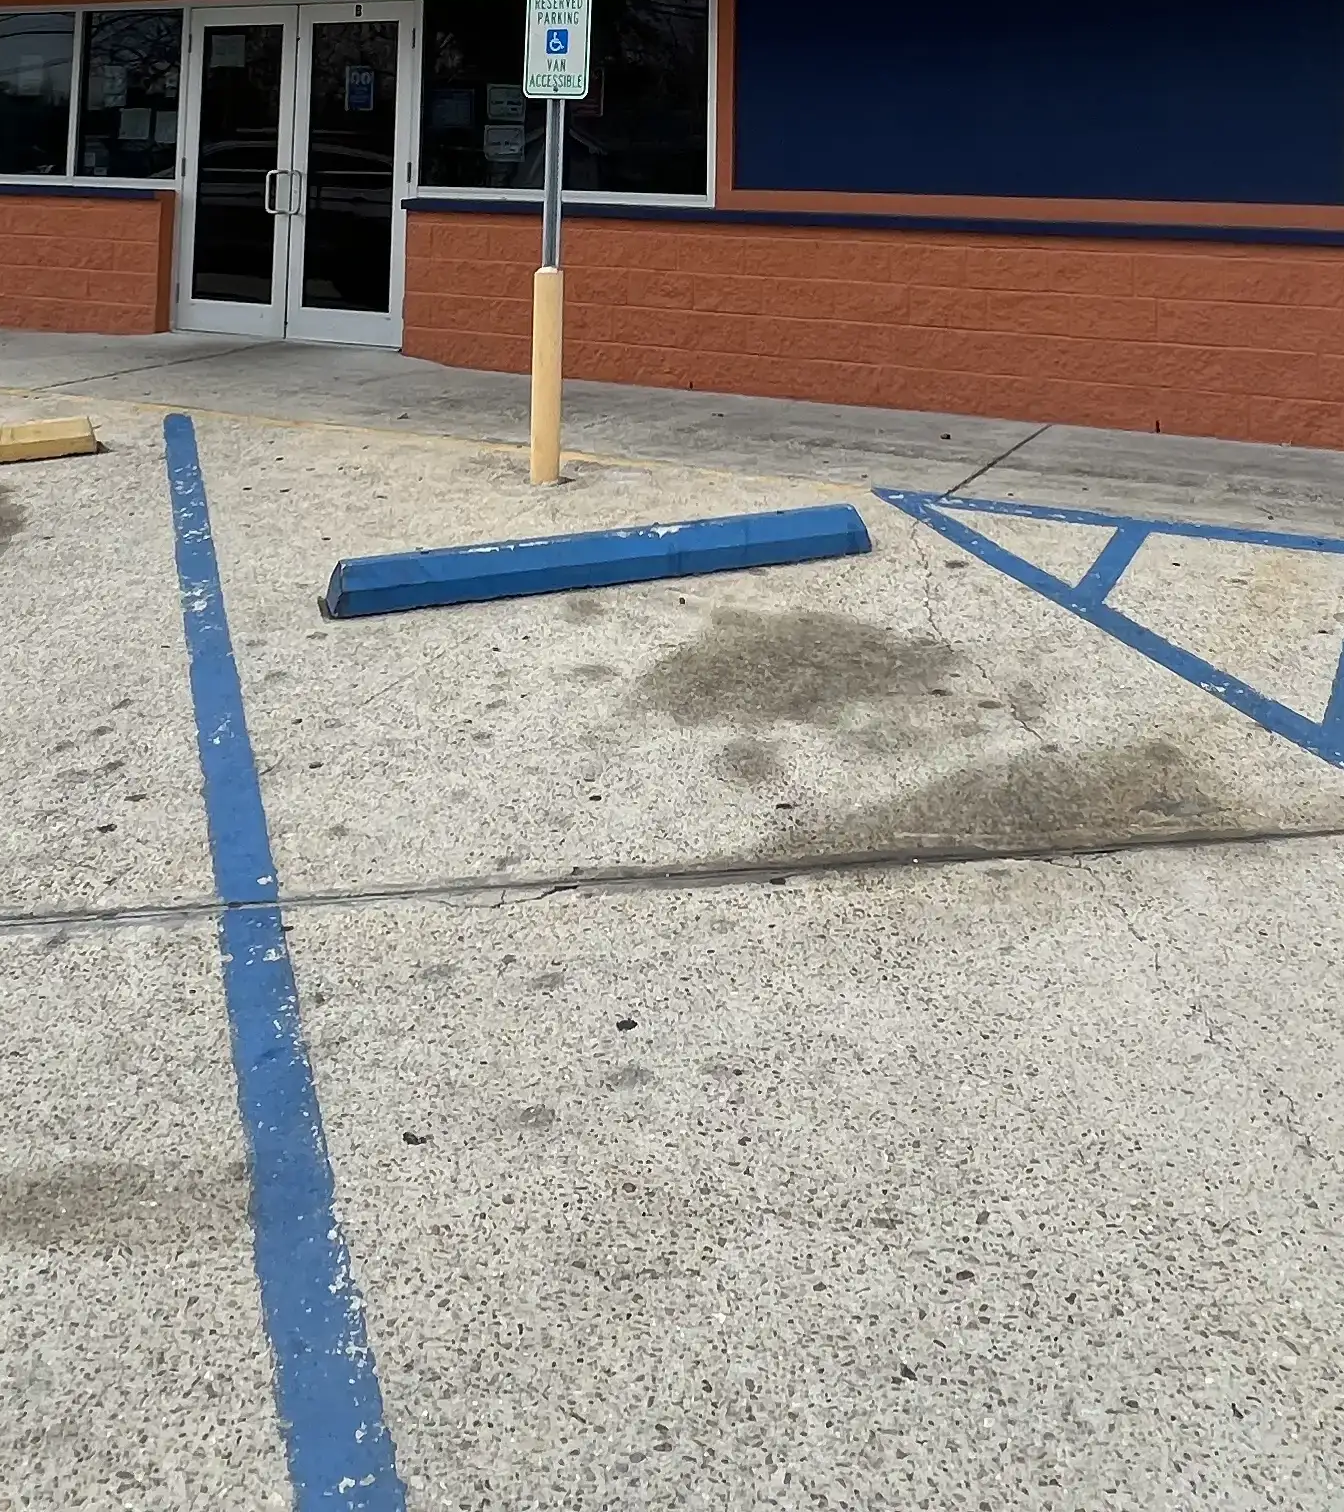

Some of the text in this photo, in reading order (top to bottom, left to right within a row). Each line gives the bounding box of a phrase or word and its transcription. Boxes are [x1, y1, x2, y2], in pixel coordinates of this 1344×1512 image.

[537, 11, 580, 26] PARKING
[546, 58, 567, 72] VAN
[528, 73, 583, 89] ACCESSIBLE
